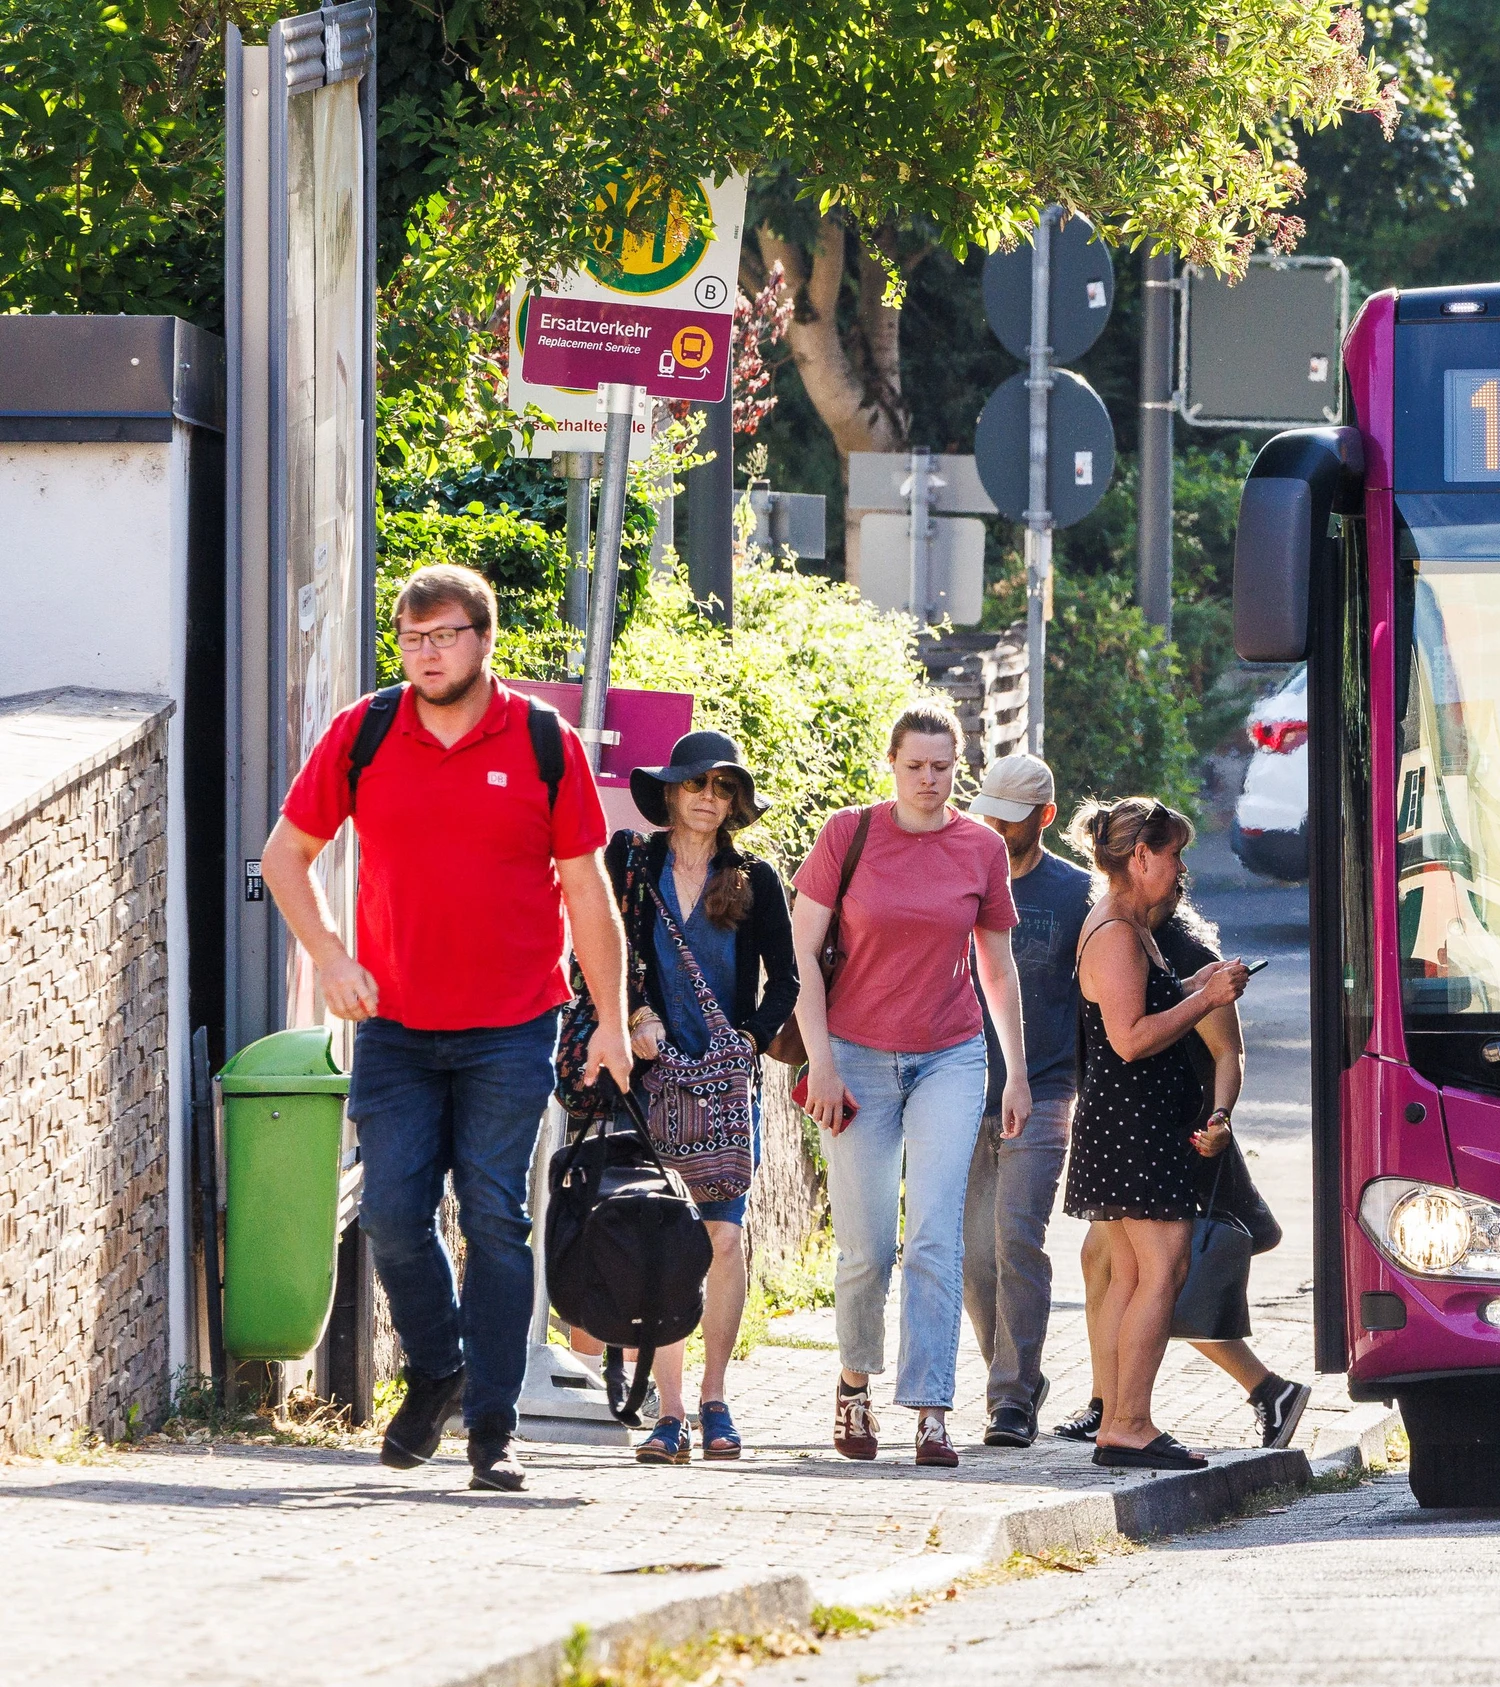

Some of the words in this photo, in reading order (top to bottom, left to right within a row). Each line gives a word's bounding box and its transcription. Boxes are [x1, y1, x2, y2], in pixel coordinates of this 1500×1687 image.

[704, 284, 717, 300] B
[540, 313, 652, 339] Ersatzverkehr
[538, 335, 603, 351] Replacement
[604, 341, 641, 355] Service
